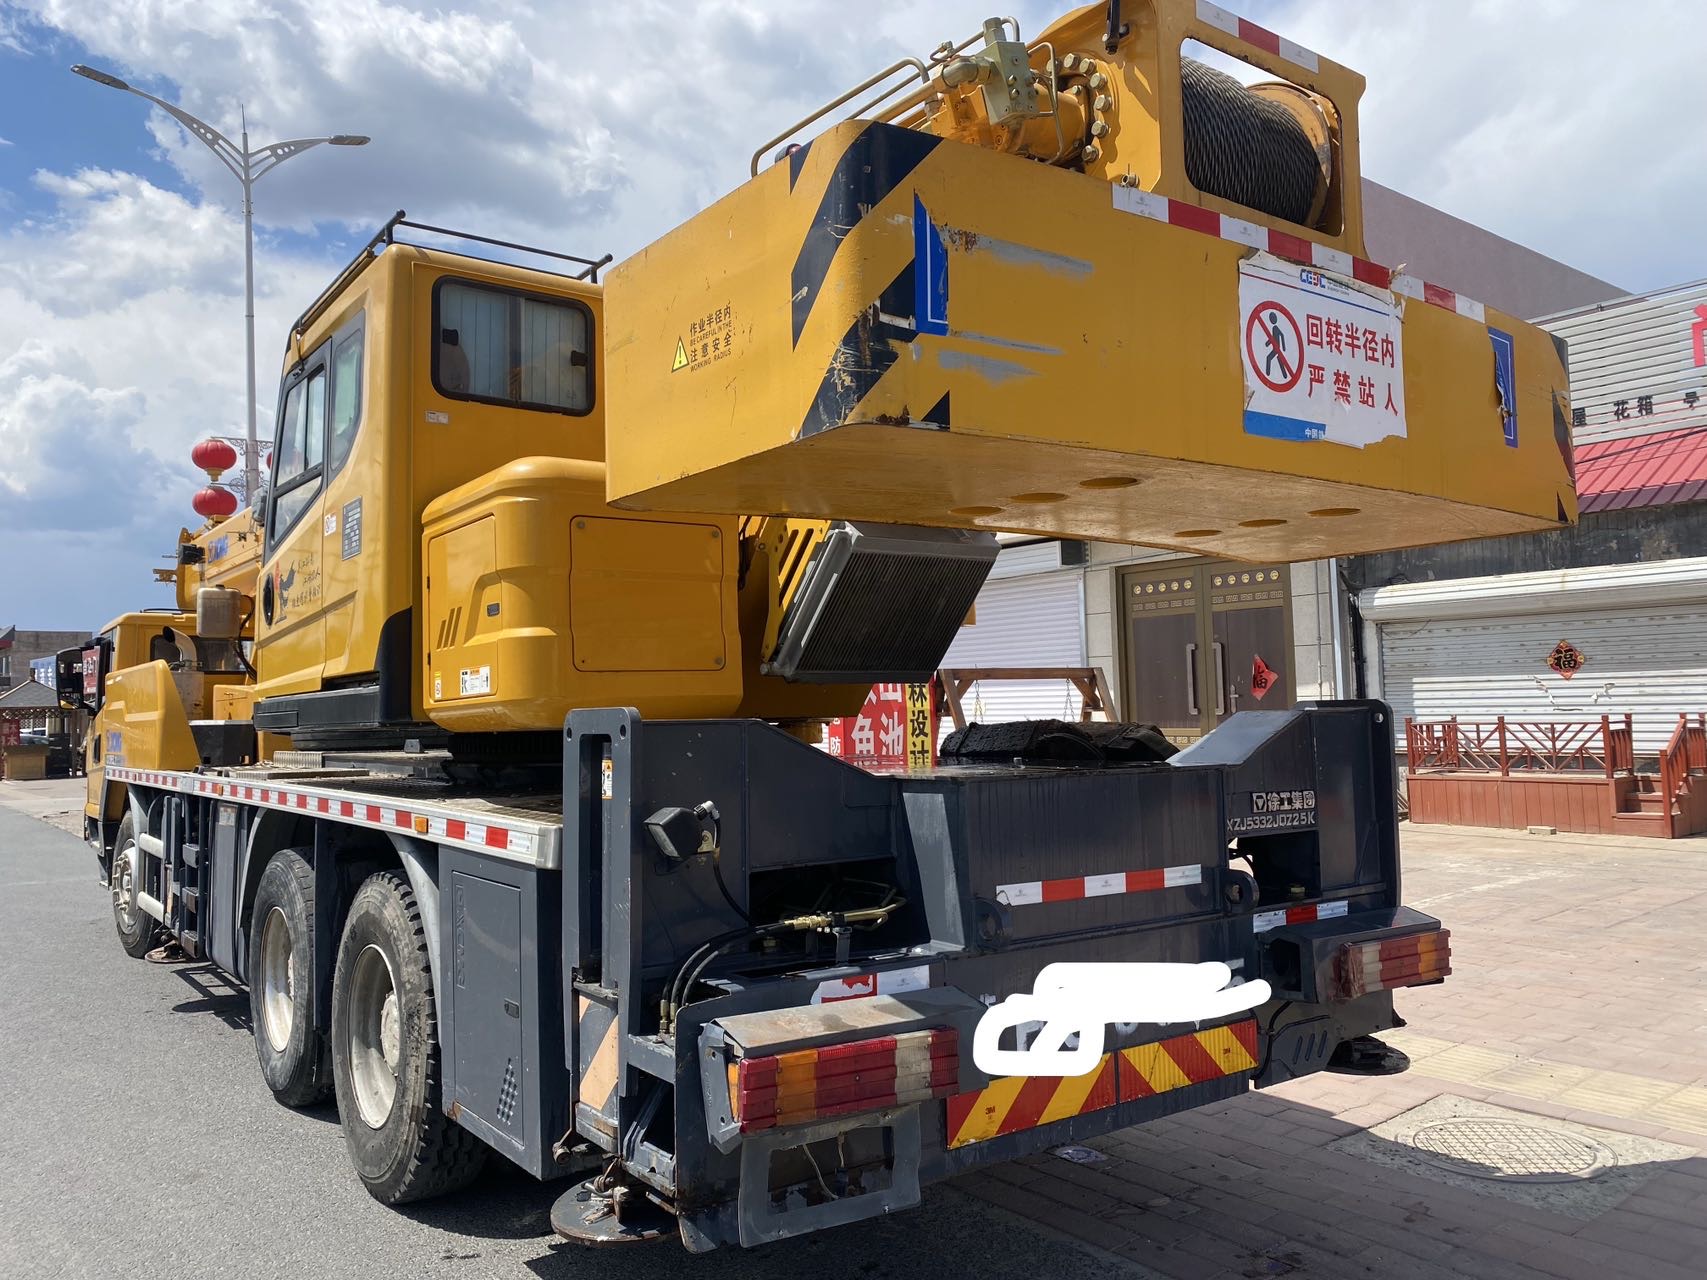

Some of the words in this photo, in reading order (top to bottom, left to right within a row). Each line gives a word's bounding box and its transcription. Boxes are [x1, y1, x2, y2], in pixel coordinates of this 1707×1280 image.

[690, 304, 731, 338] 作业半径内
[690, 331, 732, 364] 注意安全
[1306, 313, 1395, 369] 回转半径内
[690, 357, 712, 373] WORKING
[1308, 363, 1399, 417] 严禁站人
[1267, 790, 1316, 811] 徐工集团
